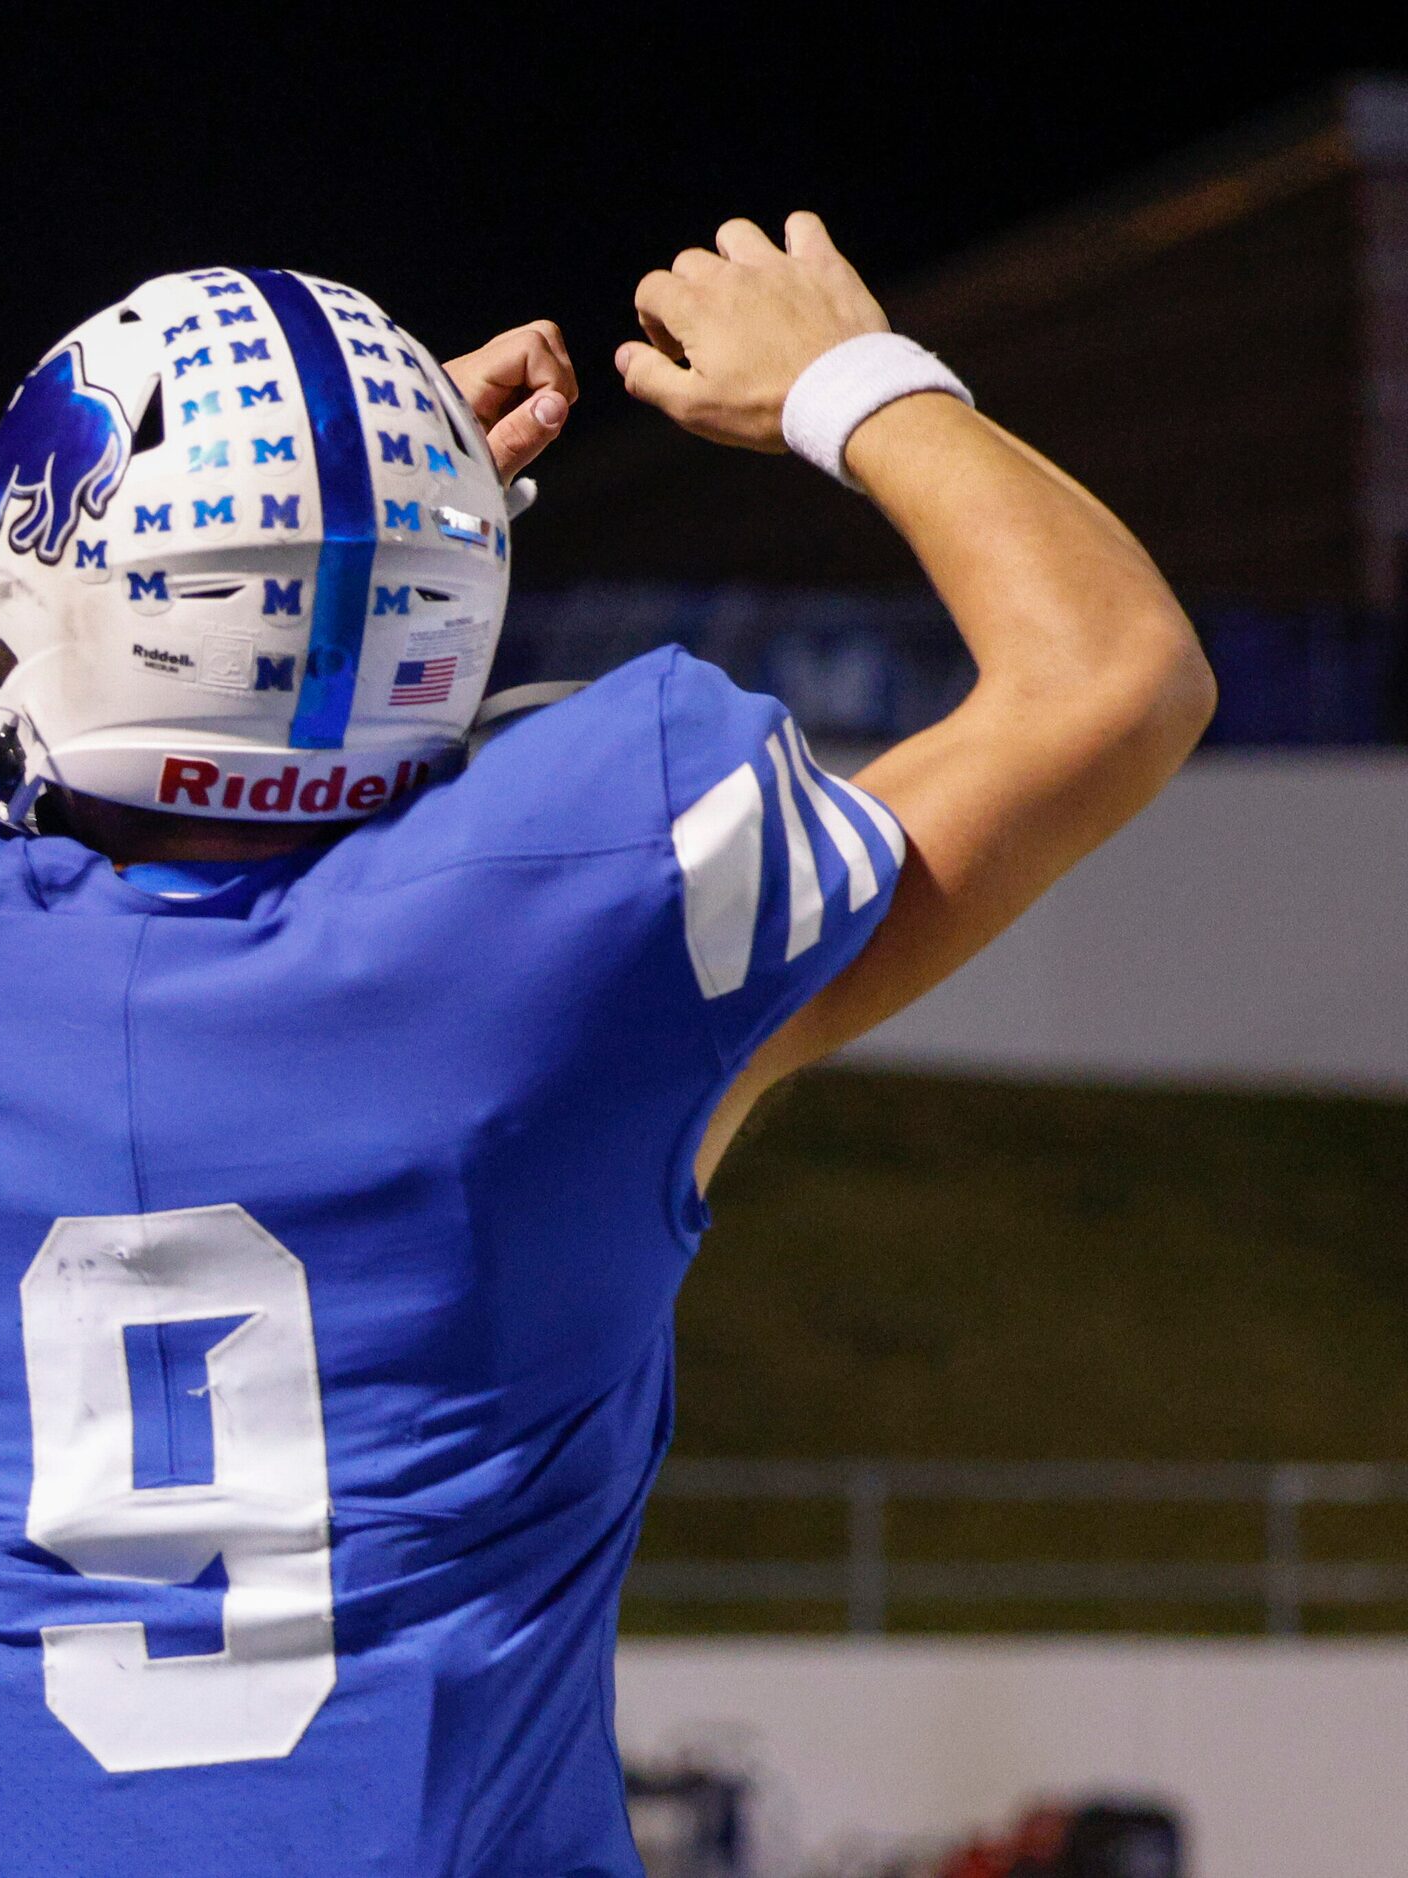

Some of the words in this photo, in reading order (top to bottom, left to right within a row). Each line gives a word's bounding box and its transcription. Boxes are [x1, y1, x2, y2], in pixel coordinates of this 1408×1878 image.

[203, 282, 245, 297] M
[313, 284, 359, 301] M
[163, 315, 201, 347] M
[214, 305, 258, 327] M
[331, 307, 376, 327] M
[172, 347, 212, 379] M
[229, 338, 271, 364] M
[347, 337, 390, 362] M
[180, 390, 222, 427] M
[236, 380, 284, 408] M
[362, 376, 401, 409] M
[187, 439, 230, 473] M
[251, 436, 296, 464] M
[377, 431, 414, 466] M
[424, 444, 458, 478] M
[134, 504, 172, 533] M
[193, 495, 235, 528] M
[260, 494, 300, 529] M
[384, 498, 422, 532] M
[75, 540, 107, 569] M
[127, 570, 169, 600] M
[262, 579, 303, 615] M
[373, 585, 411, 616] M
[255, 656, 295, 691] M
[156, 755, 429, 814] Riddell
[20, 1203, 337, 1774] 9
